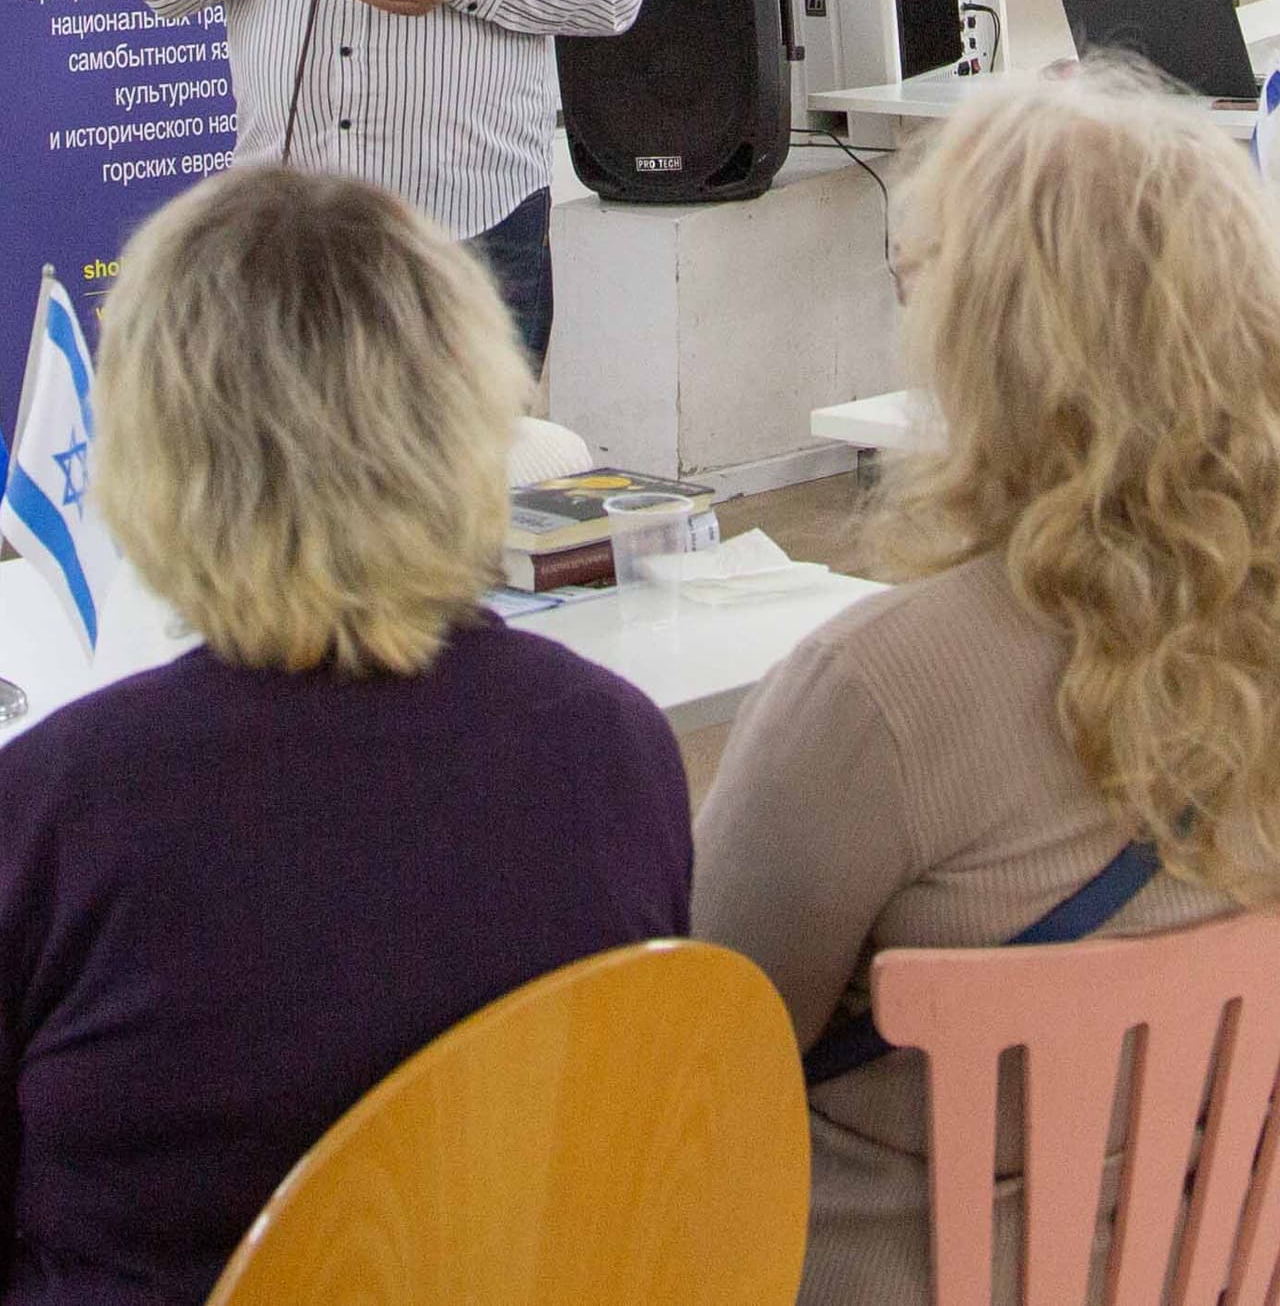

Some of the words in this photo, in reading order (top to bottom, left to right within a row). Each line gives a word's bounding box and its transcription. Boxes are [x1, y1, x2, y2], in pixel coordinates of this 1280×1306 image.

[69, 42, 206, 72] самобытности
[211, 42, 229, 60] яз
[115, 77, 228, 112] культурного
[49, 131, 61, 150] и
[65, 117, 204, 150] исторического
[208, 113, 238, 134] нас
[102, 157, 177, 187] горских
[181, 149, 234, 178] еврее
[83, 258, 120, 280] sho
